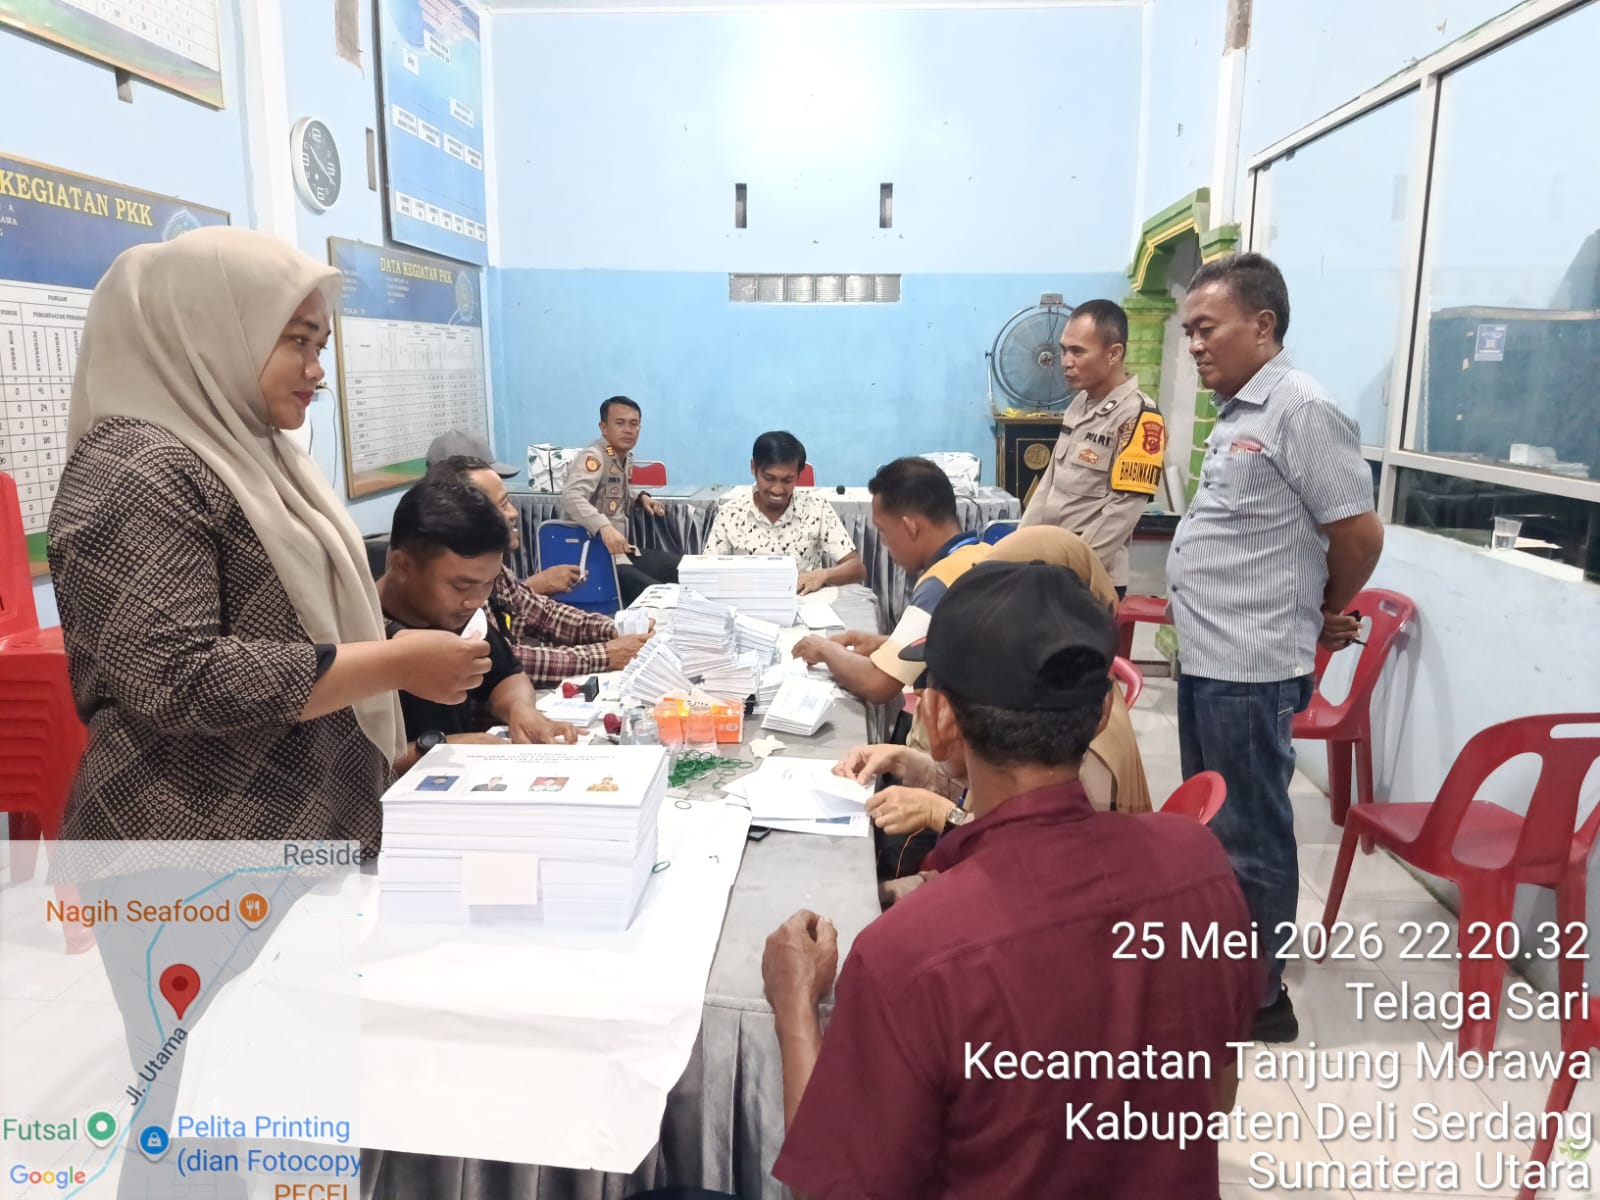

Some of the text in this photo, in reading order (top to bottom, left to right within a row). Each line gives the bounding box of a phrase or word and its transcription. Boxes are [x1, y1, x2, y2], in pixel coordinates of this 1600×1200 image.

[0, 169, 153, 227] KEGIATAN PKK
[0, 215, 18, 226] AWA
[380, 256, 401, 275] DATA
[1084, 431, 1111, 446] POLRI
